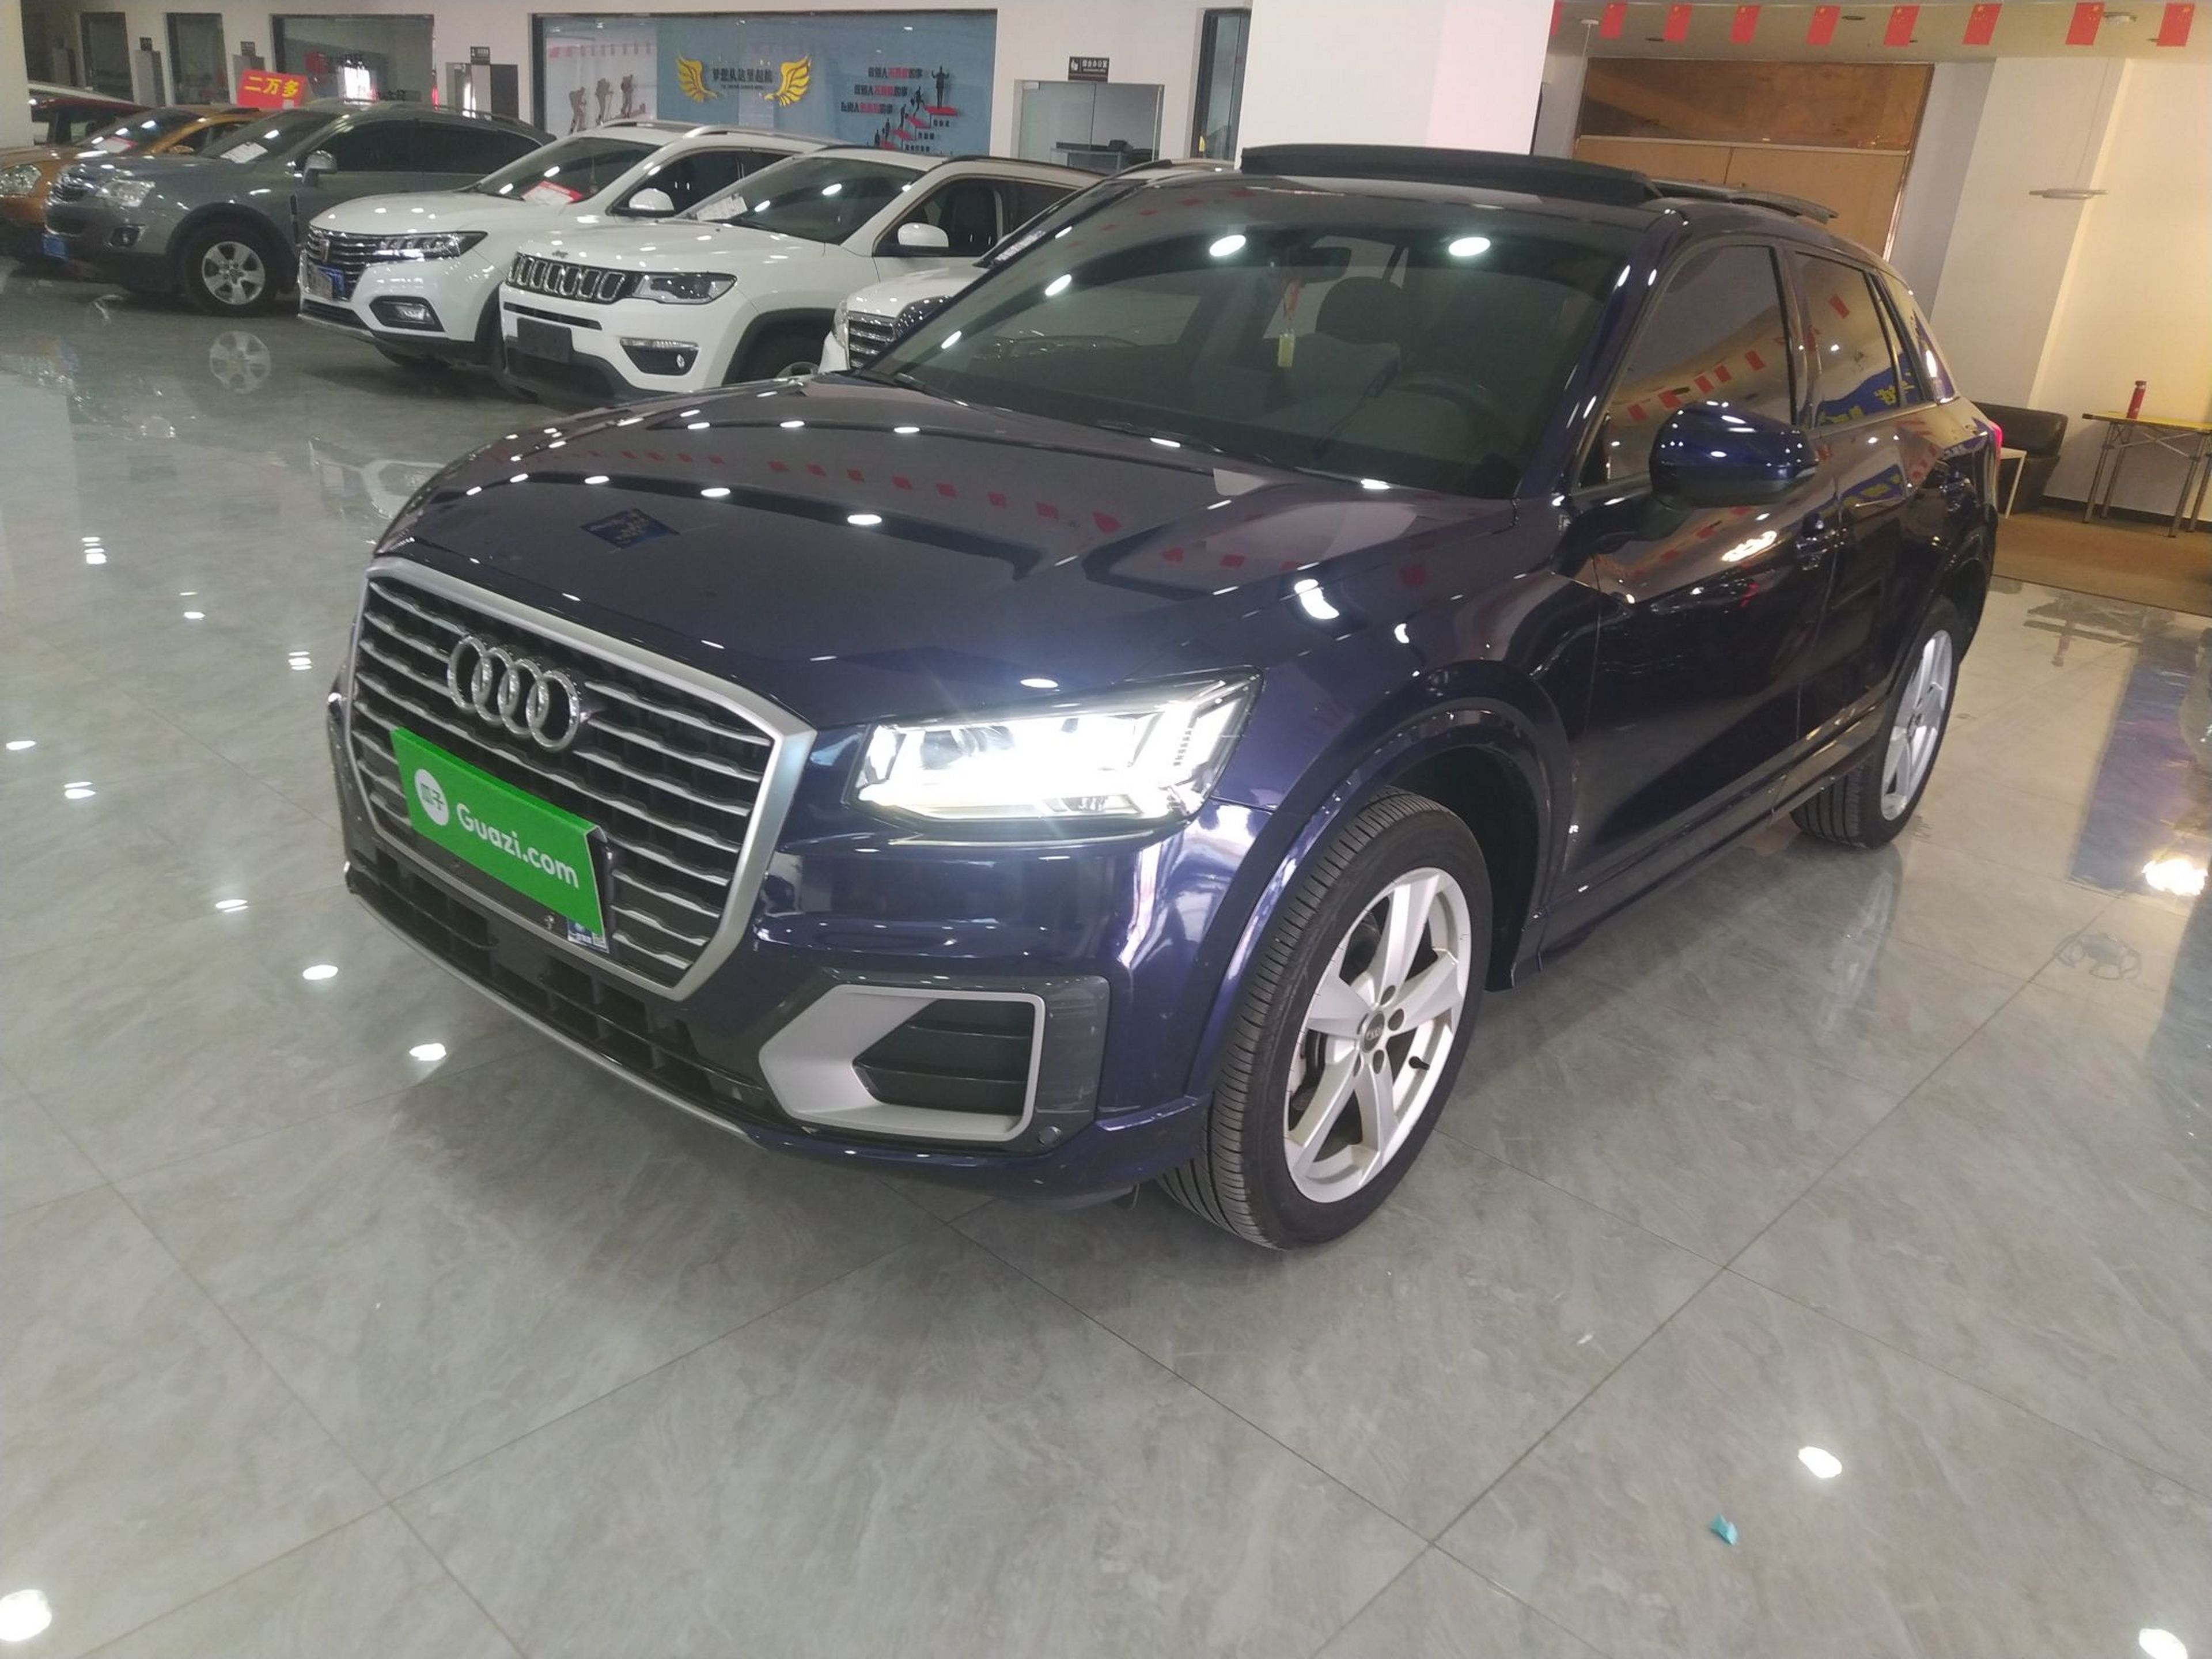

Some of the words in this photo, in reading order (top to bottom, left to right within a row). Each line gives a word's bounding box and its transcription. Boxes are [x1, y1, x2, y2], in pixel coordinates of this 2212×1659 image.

[245, 76, 300, 97] 二万多
[457, 803, 579, 889] Guazi.com
